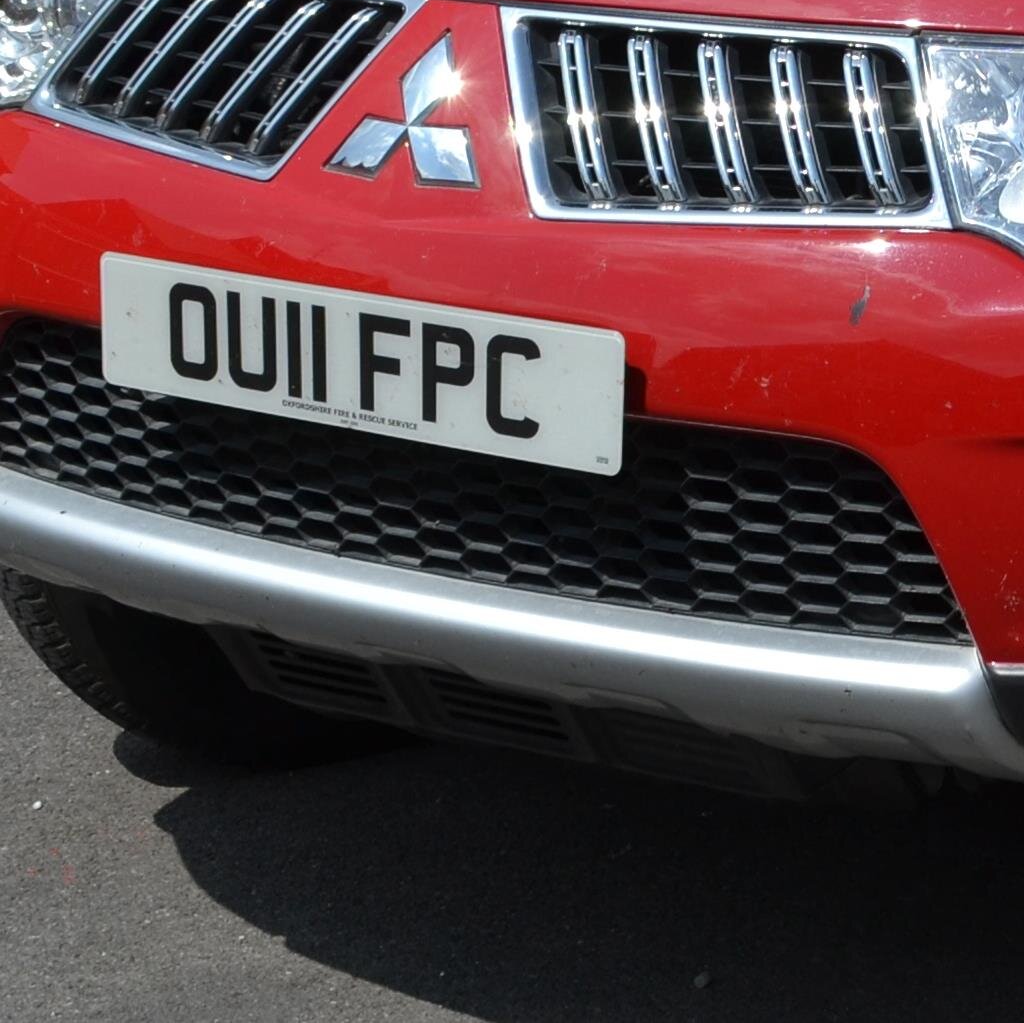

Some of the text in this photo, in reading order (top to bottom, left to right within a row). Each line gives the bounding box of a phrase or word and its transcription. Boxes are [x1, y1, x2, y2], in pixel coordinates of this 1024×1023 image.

[169, 282, 541, 439] OU11 FPC
[282, 399, 331, 415] OXFORDSHIRE
[334, 408, 350, 418] FIRE
[359, 413, 386, 425] RESCUE
[388, 418, 418, 430] SERVICE
